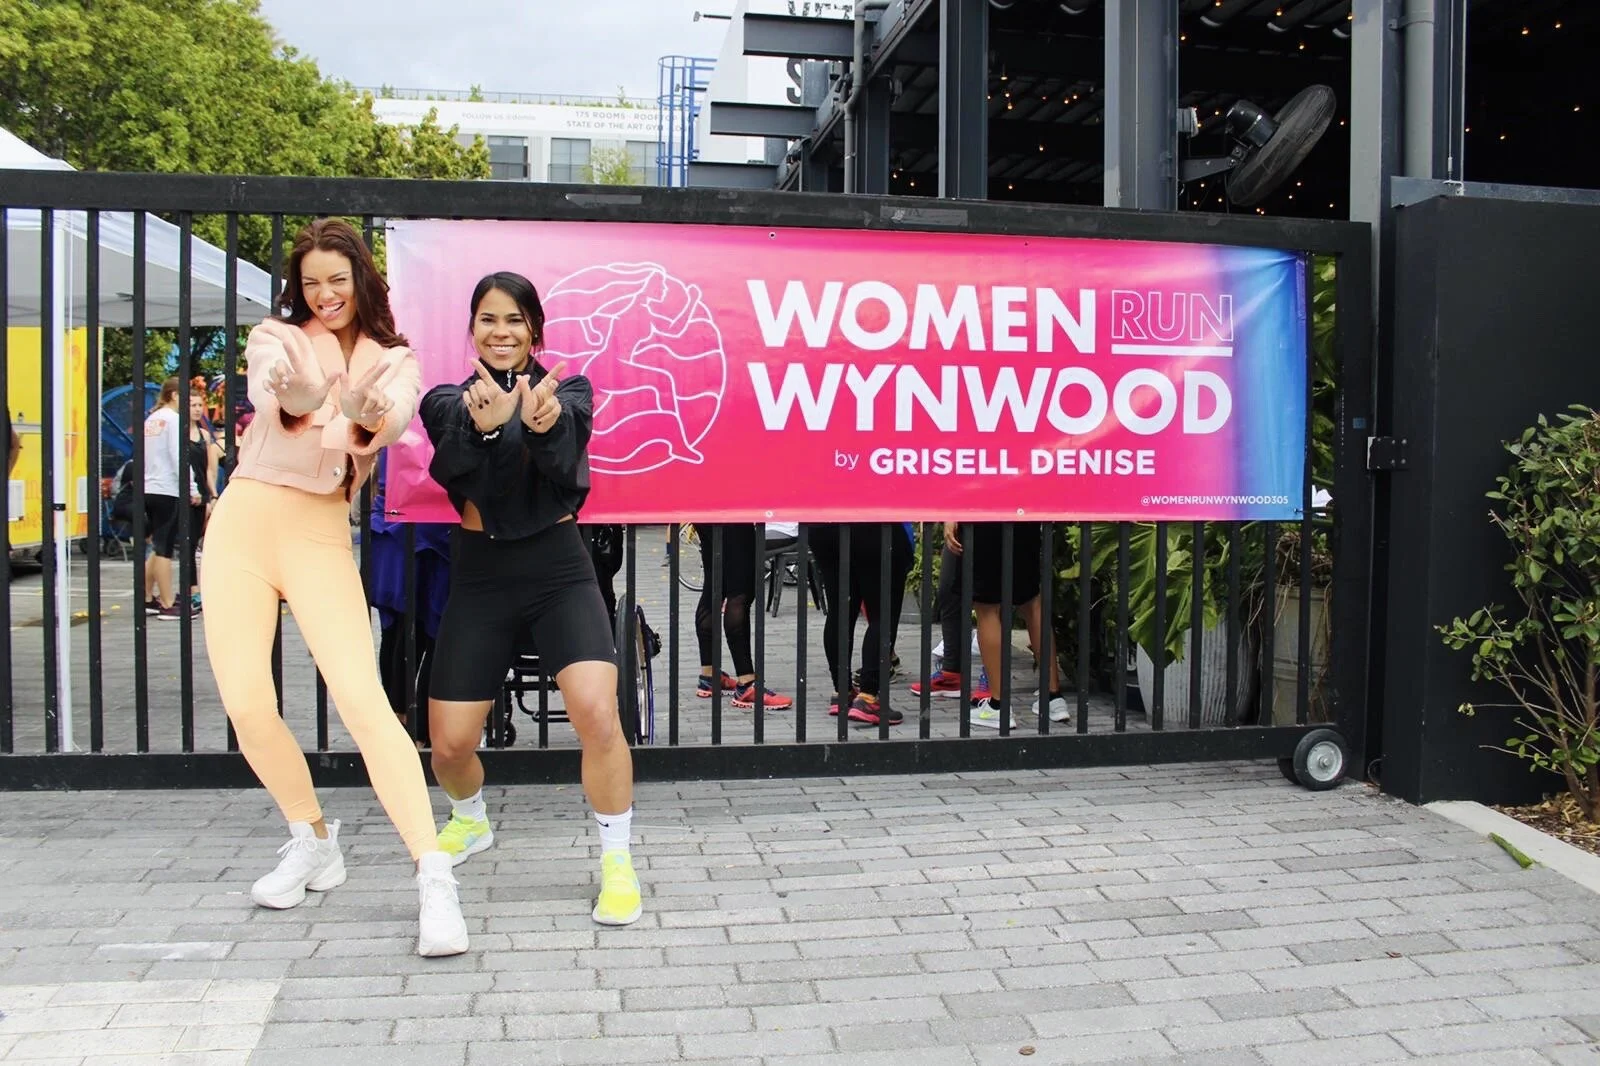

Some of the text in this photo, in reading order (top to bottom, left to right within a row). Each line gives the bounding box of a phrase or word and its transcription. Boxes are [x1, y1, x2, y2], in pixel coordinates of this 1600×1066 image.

[592, 111, 626, 120] ROOMS
[746, 280, 1234, 354] WOMEN RUN
[747, 362, 1232, 435] WYNWOOD
[835, 448, 1156, 475] by GRISELL DENISE
[1140, 495, 1289, 507] @WOMENRUNWYNWOOD305
